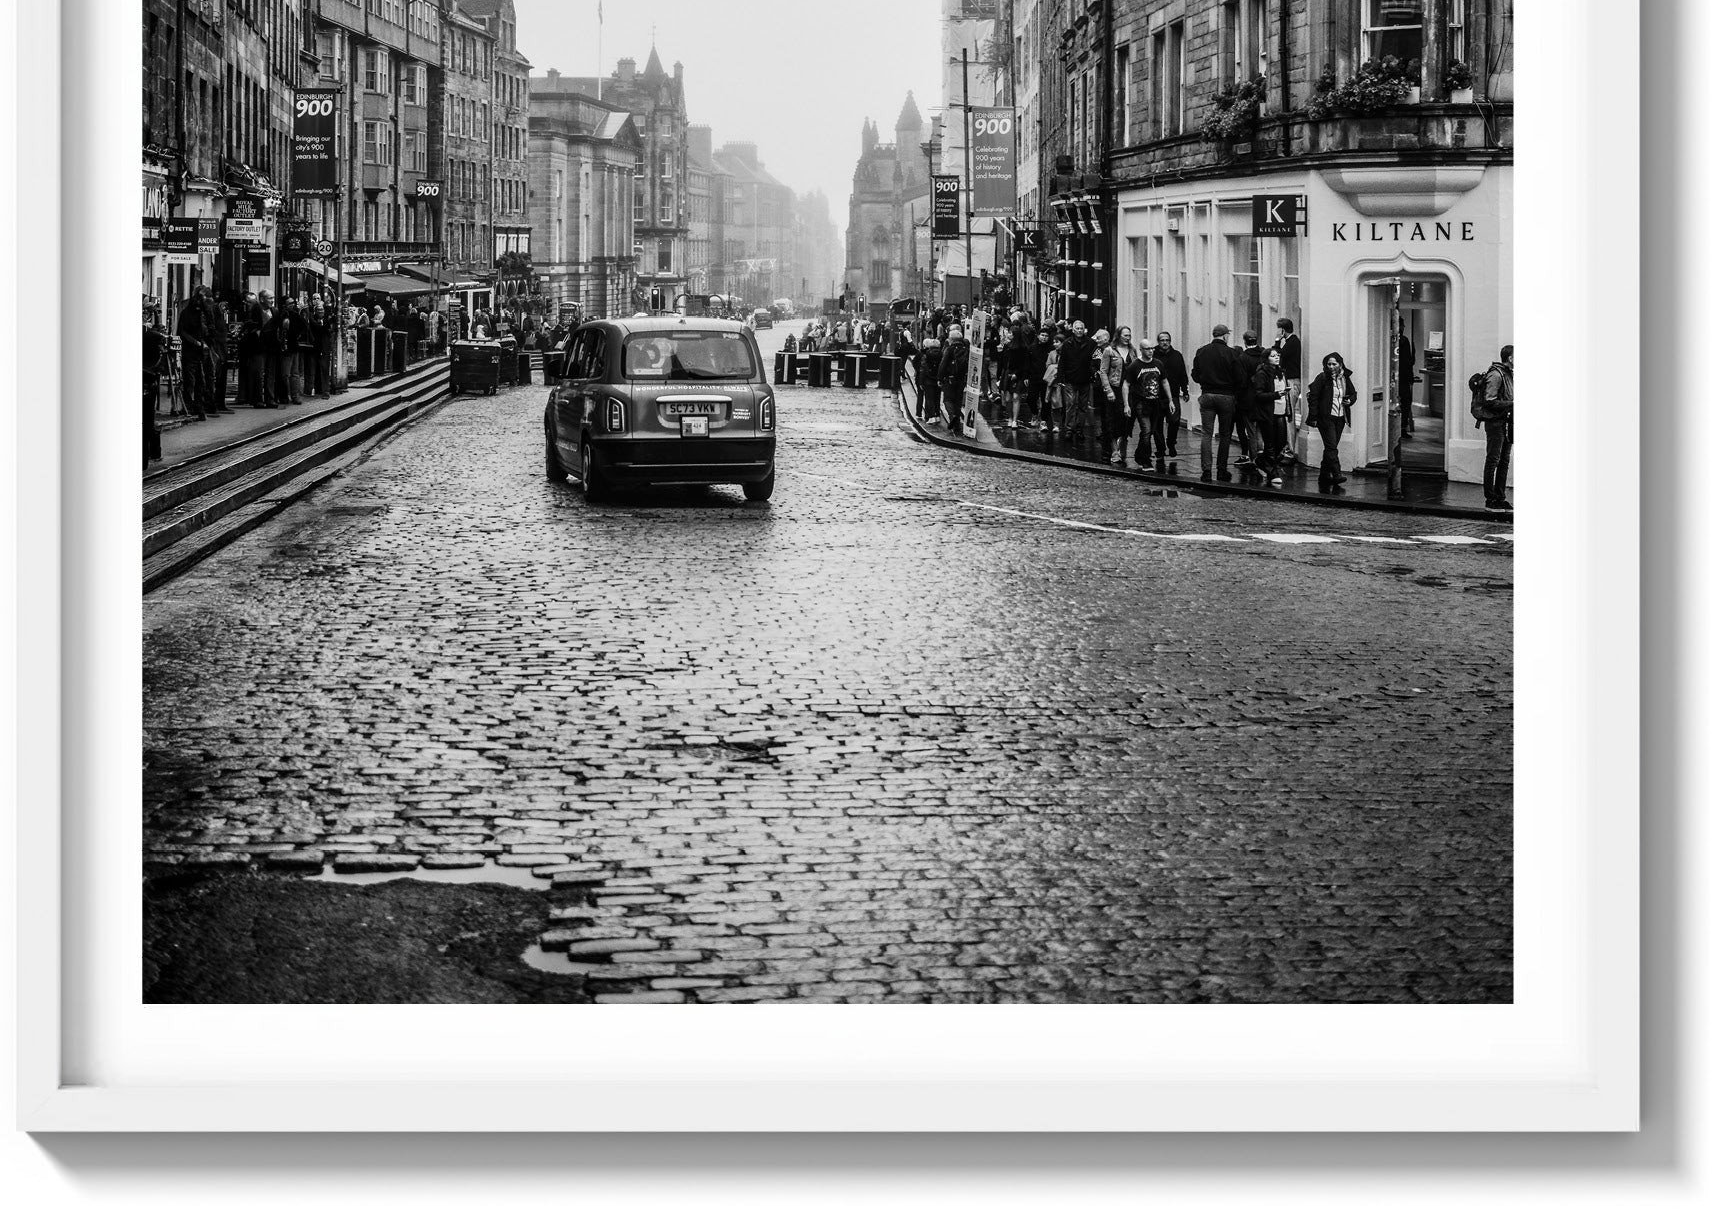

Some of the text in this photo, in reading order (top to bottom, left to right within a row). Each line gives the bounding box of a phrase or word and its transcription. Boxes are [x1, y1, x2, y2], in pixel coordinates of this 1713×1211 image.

[296, 100, 333, 118] 900
[975, 118, 1012, 137] 900
[296, 135, 320, 143] Bringing
[975, 145, 1009, 153] Celebrating
[983, 163, 1002, 171] history
[988, 172, 1012, 180] heritage
[417, 185, 440, 197] 900
[936, 181, 958, 193] 900
[1266, 200, 1285, 223] K
[1333, 222, 1475, 241] KILTANE
[1024, 232, 1035, 245] K
[319, 244, 331, 252] 20
[670, 403, 716, 413] SC73 VKW
